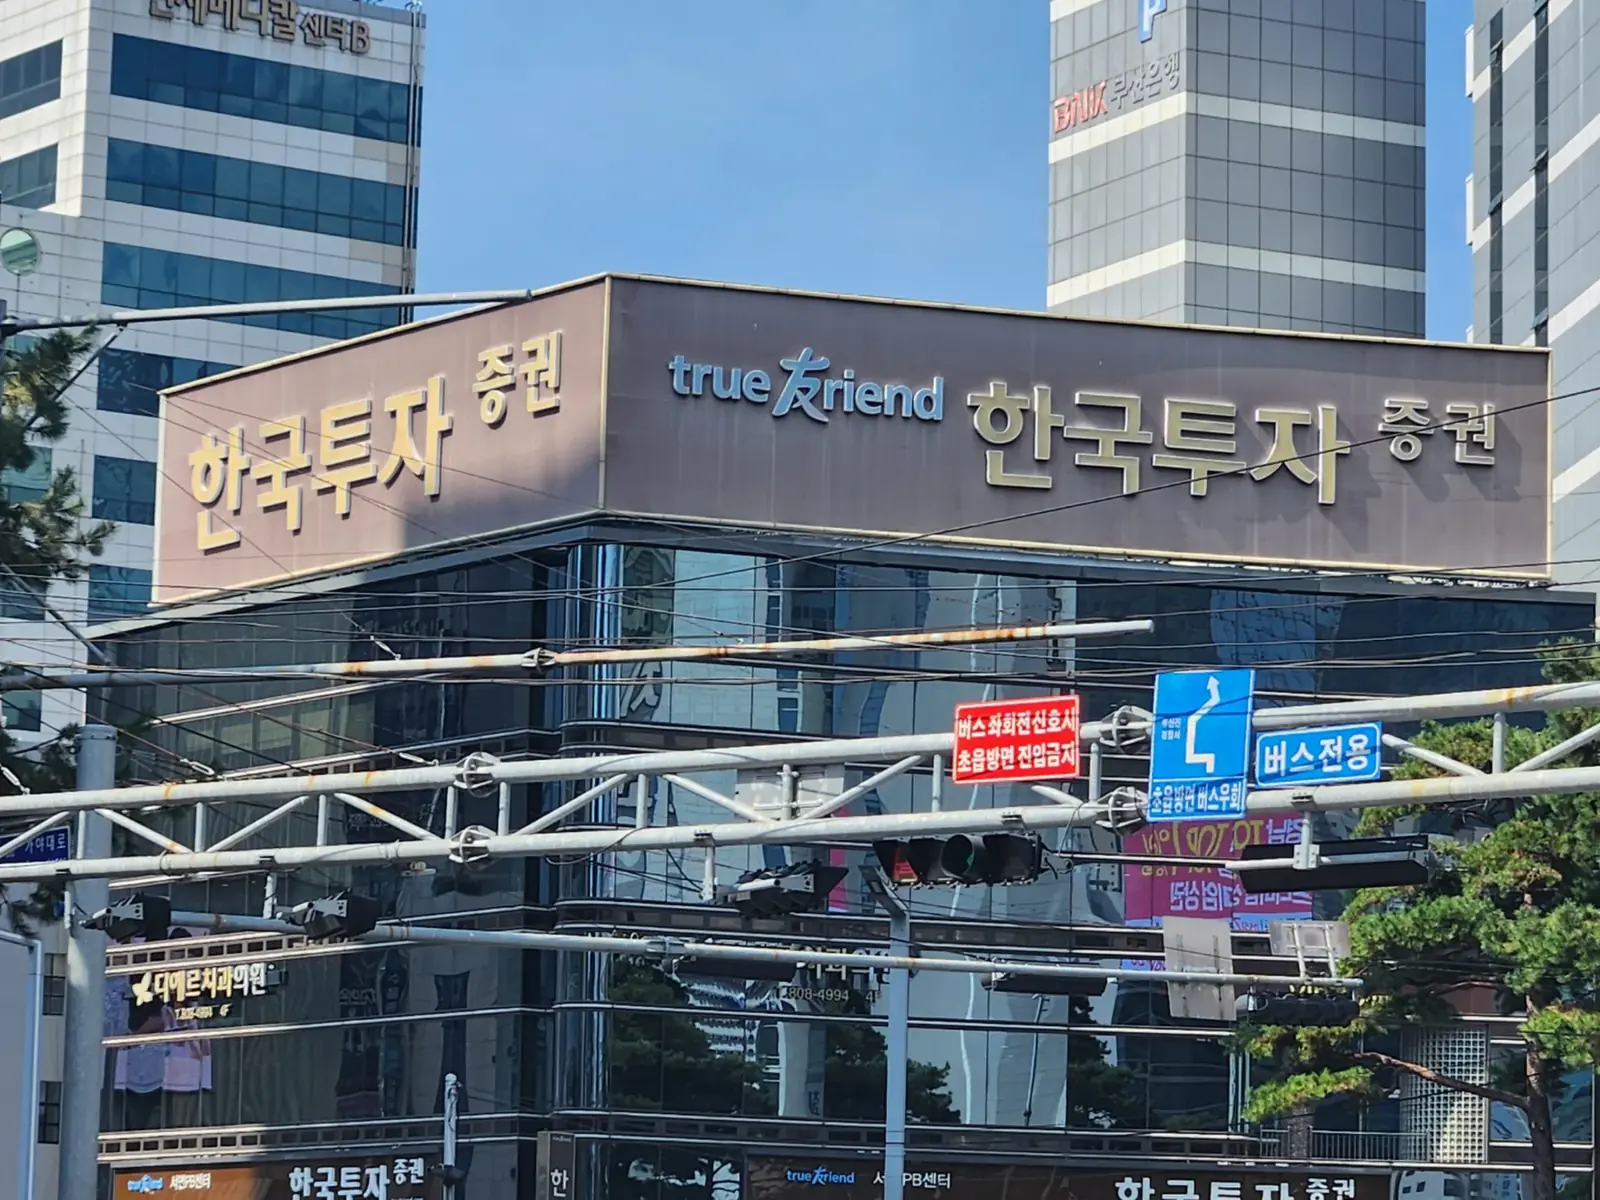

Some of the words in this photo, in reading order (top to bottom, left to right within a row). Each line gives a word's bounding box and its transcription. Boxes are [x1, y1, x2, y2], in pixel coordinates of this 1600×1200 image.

[188, 375, 453, 554] 한국투자
[472, 330, 564, 429] 증권
[967, 380, 1351, 505] 한국투자
[1378, 397, 1497, 466] 증권
[959, 714, 986, 741] 버스
[957, 744, 1015, 774] 초읍방면
[1018, 740, 1075, 770] 진입금지
[1264, 733, 1371, 776] 버스전용
[1151, 783, 1196, 815] 초읍방면
[1197, 781, 1243, 813] 버스우회
[288, 1164, 391, 1200] 한국투자
[393, 1157, 425, 1185] 증권
[550, 1168, 570, 1198] 한
[873, 1171, 951, 1190] 서PB센터
